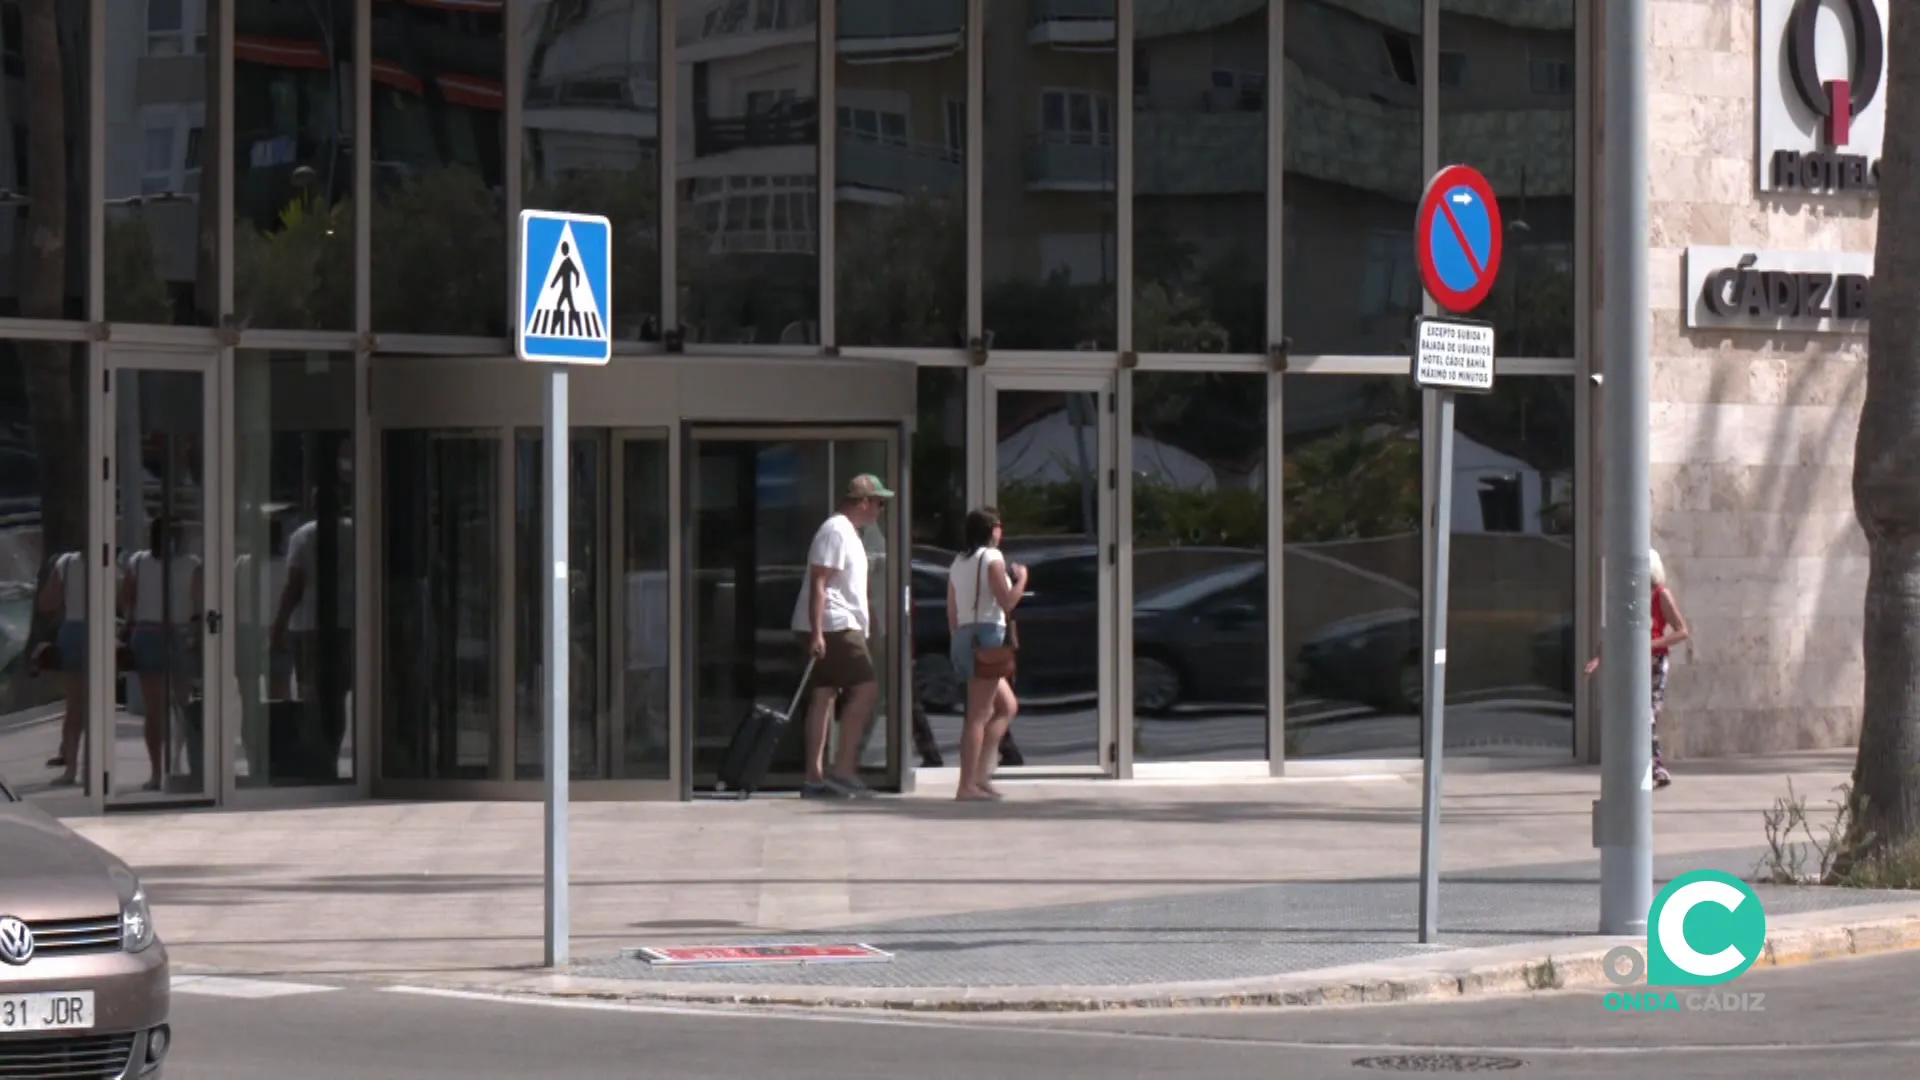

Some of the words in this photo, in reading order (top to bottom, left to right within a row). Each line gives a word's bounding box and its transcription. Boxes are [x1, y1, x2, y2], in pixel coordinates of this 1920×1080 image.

[1703, 253, 1833, 319] CÁDIZ
[1838, 275, 1871, 319] B
[1427, 326, 1455, 338] EXCEPTO
[1457, 329, 1481, 340] SUBIDA
[1421, 339, 1445, 351] BAJADA
[1447, 342, 1455, 352] DE
[1457, 344, 1491, 356] USUARIOS
[1423, 355, 1443, 365] HOTEL
[1449, 371, 1456, 380] 10
[1458, 372, 1488, 382] MINUTOS
[3, 1000, 27, 1026] 31
[43, 997, 83, 1025] JDR
